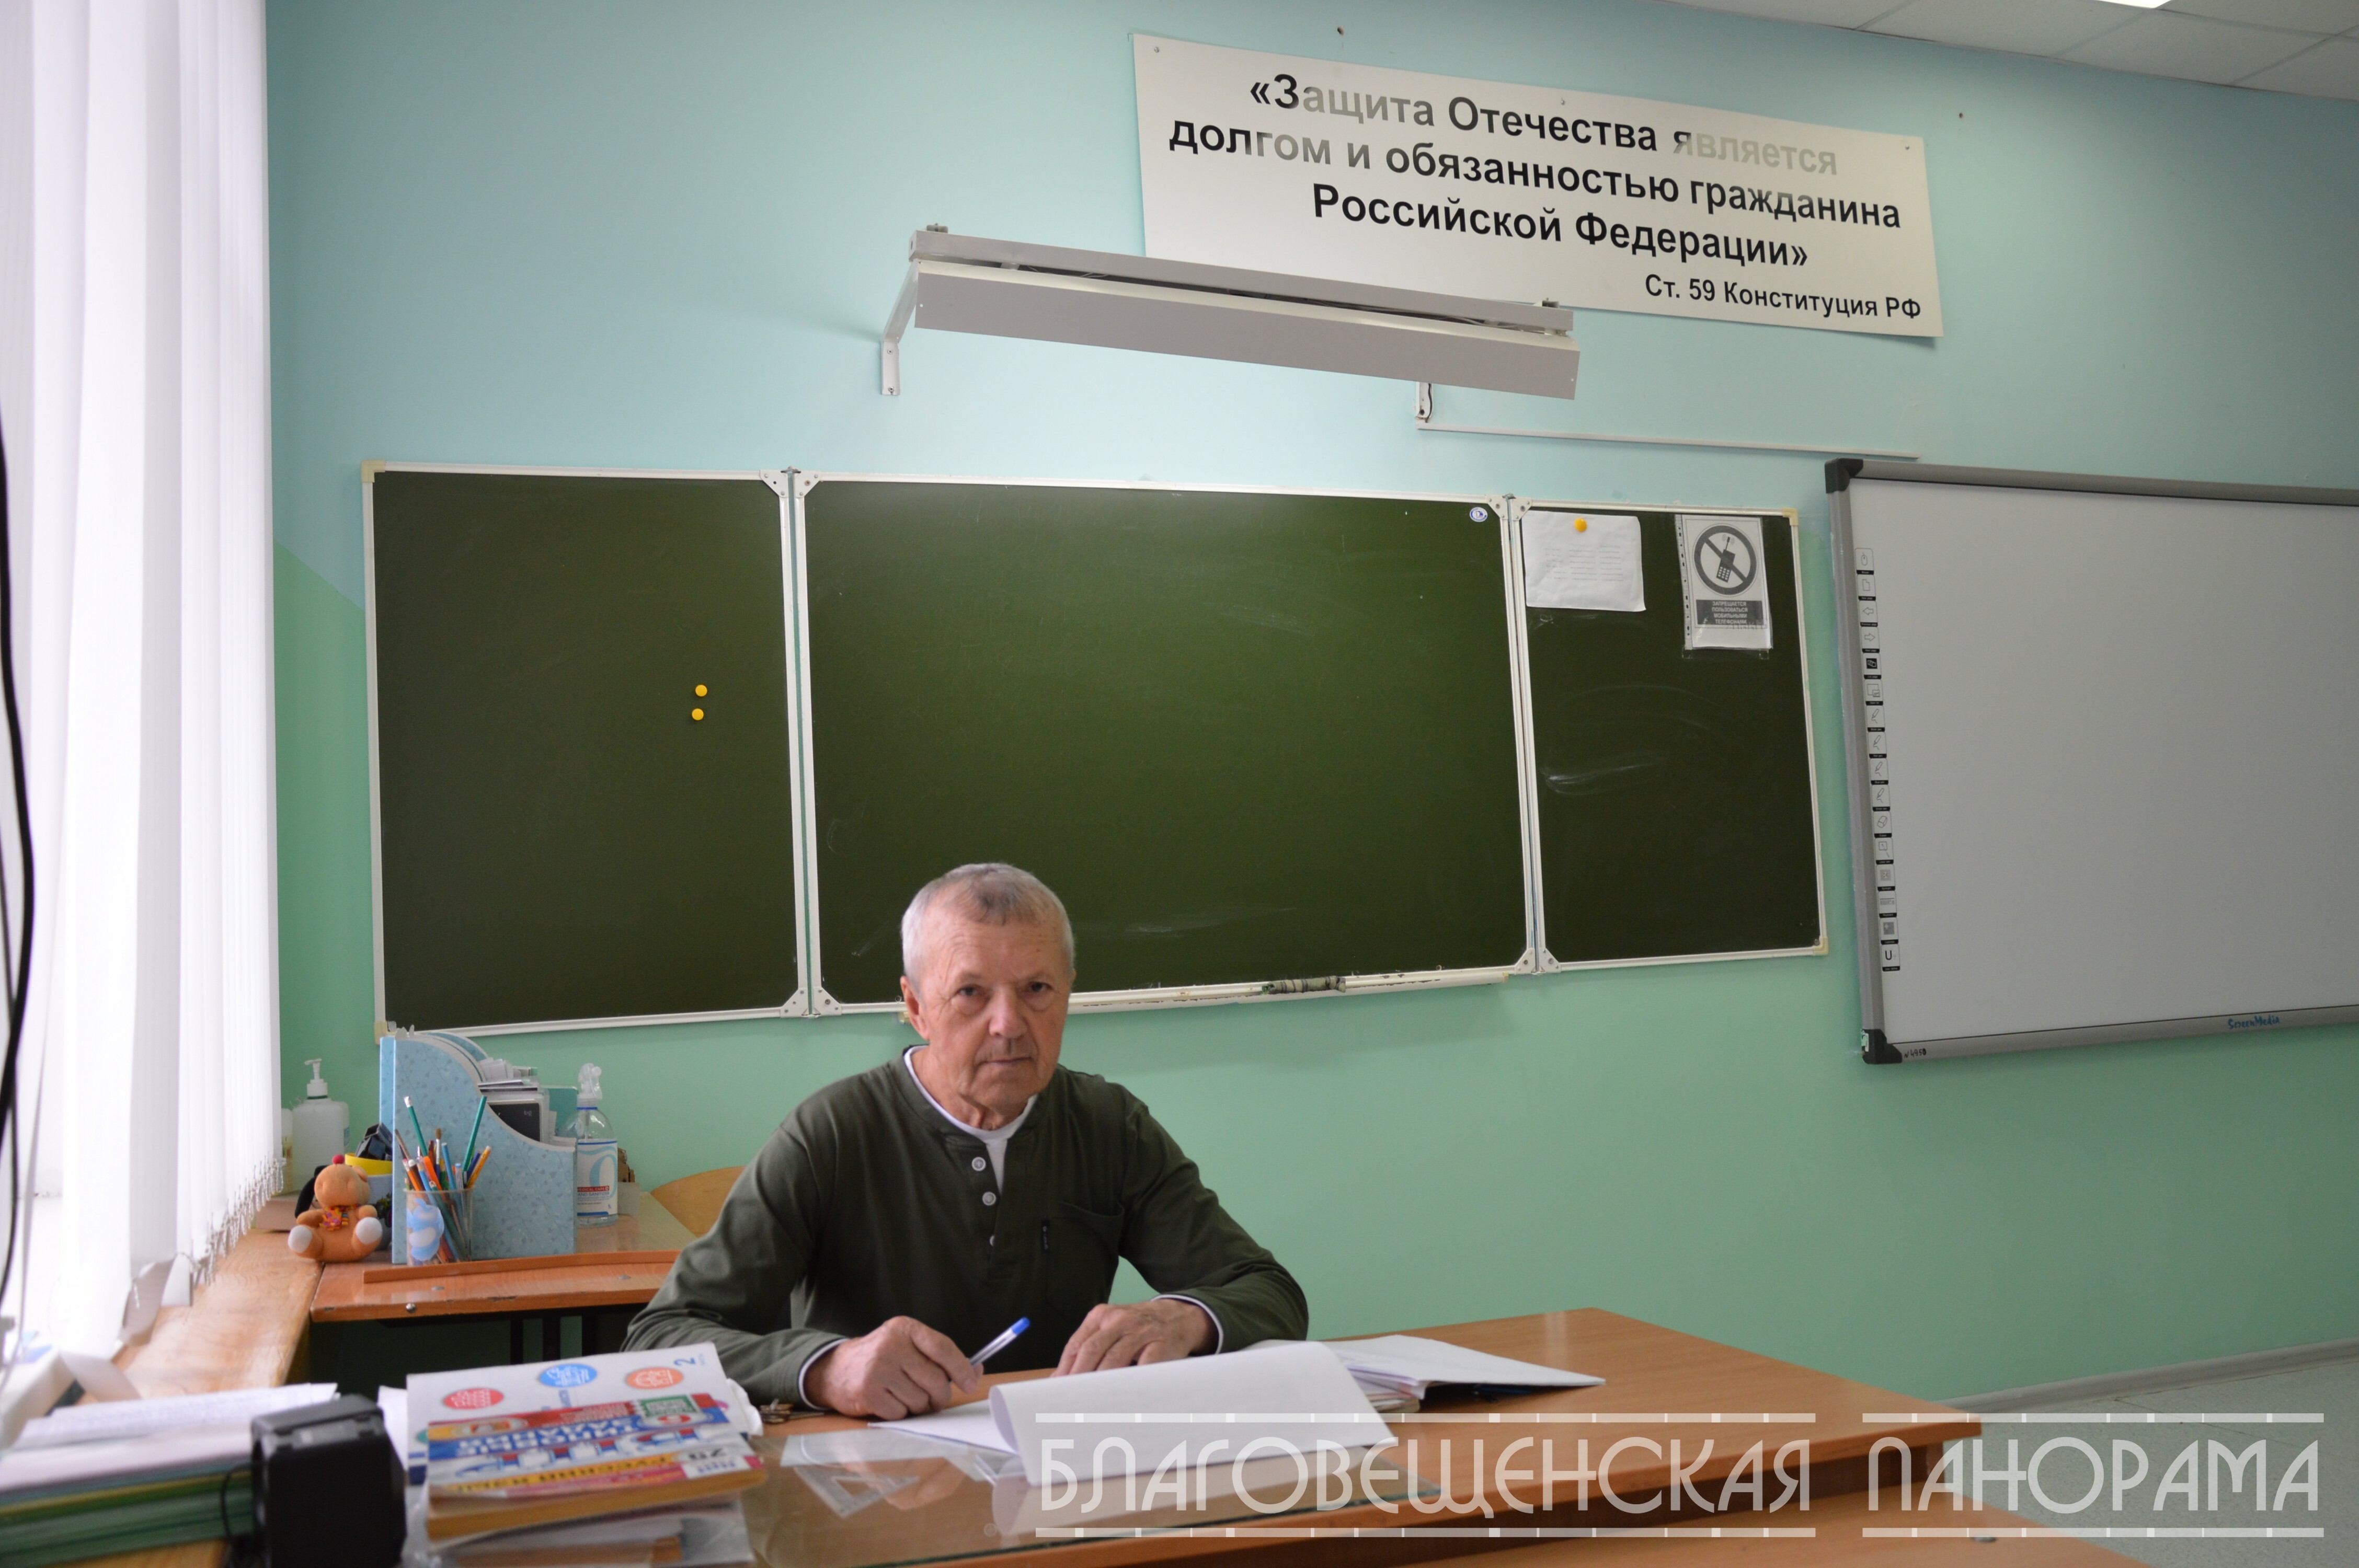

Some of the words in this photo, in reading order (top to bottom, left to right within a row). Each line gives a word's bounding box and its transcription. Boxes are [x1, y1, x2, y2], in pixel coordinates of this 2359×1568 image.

[1250, 74, 1434, 126] «Защита
[1449, 96, 1657, 152] Отечества
[1673, 130, 1837, 175] является
[1170, 120, 1331, 165] долгом
[1347, 143, 1370, 169] и
[1386, 142, 1679, 202] обязанностью
[1690, 180, 1900, 228] гражданина
[1313, 183, 1561, 241] Российской
[1575, 212, 1808, 267] Федерации»
[1645, 274, 1680, 298] Ст.
[1689, 279, 1715, 301] 59
[1724, 282, 1877, 318] Конституция
[1886, 297, 1921, 319] РФ
[2228, 1015, 2280, 1029] ScreenMedia
